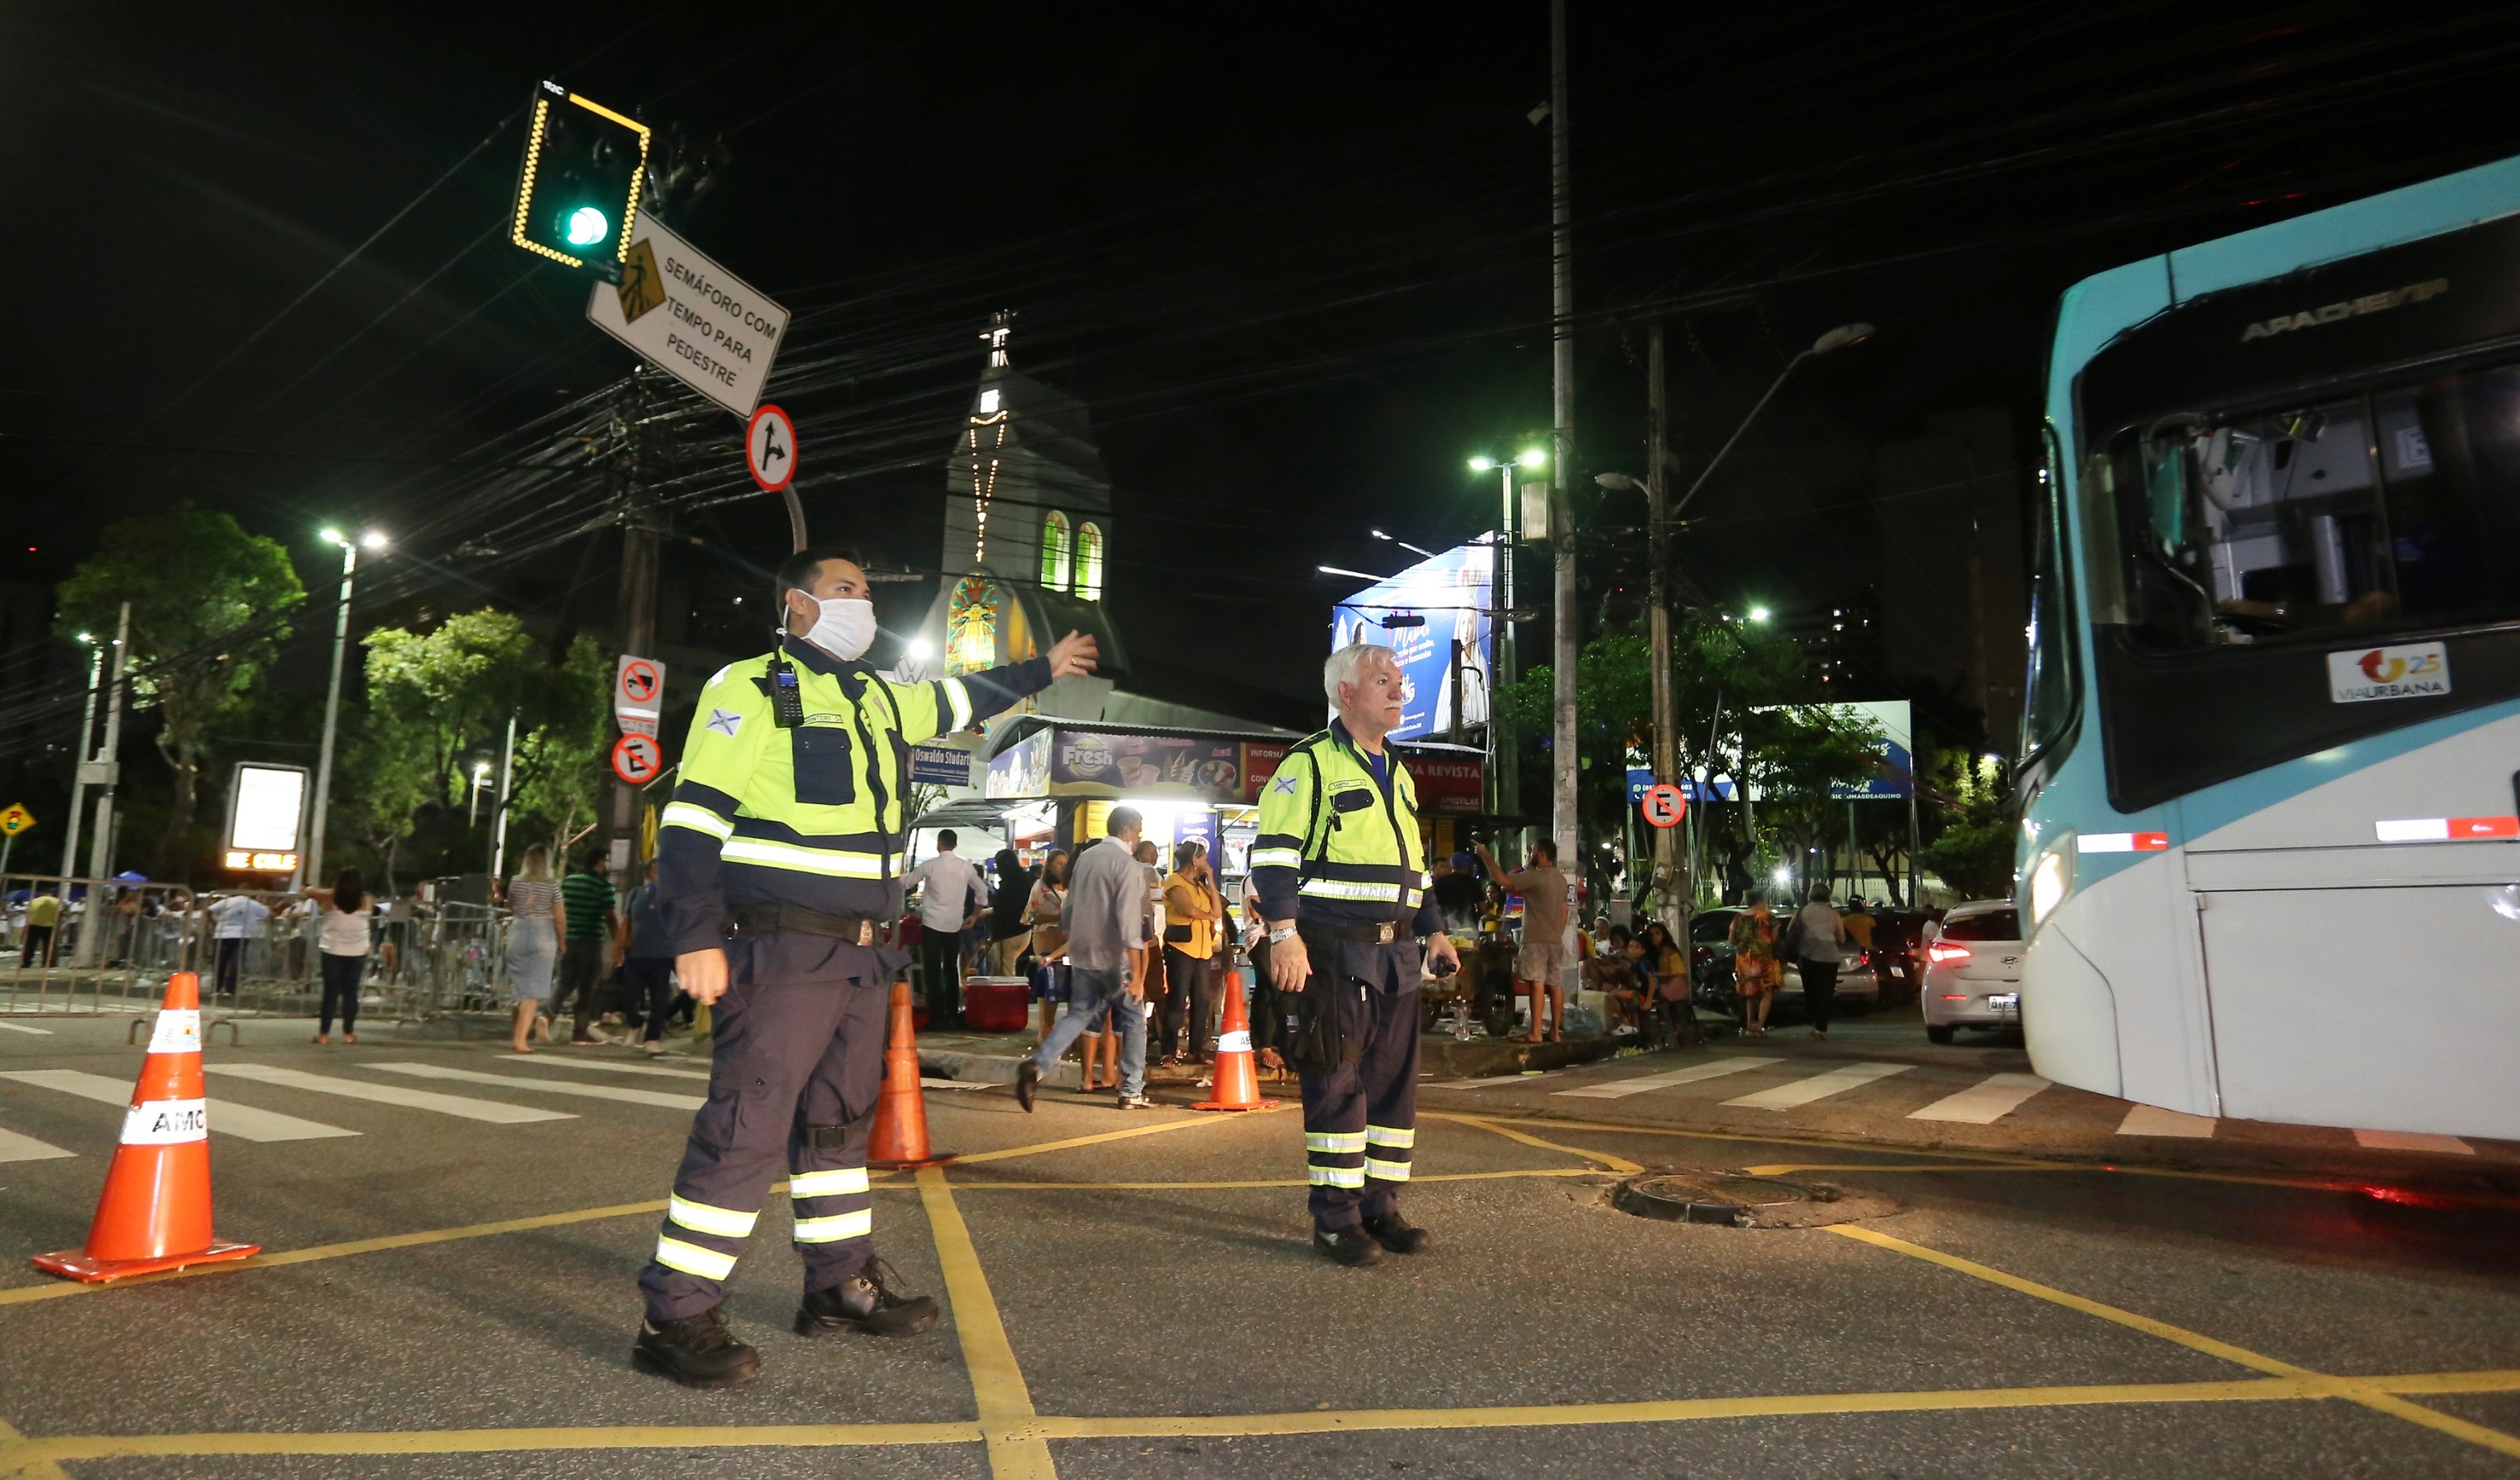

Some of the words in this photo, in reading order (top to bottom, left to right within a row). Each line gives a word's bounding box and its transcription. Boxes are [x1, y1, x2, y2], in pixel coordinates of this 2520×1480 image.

[665, 257, 742, 317] SEMÁFORO
[744, 312, 776, 340] COM
[667, 296, 712, 336] TEMPO
[714, 330, 752, 363] PARA
[666, 333, 737, 387] PEDESTRE
[2410, 654, 2442, 674] 25
[915, 748, 944, 764] Oswaldo
[945, 752, 970, 765] Studart
[1062, 745, 1113, 765] Fresh
[1250, 749, 1284, 758] INFORMÁ
[1428, 765, 1480, 779] REVISTA
[1440, 796, 1480, 805] APOSTILAS
